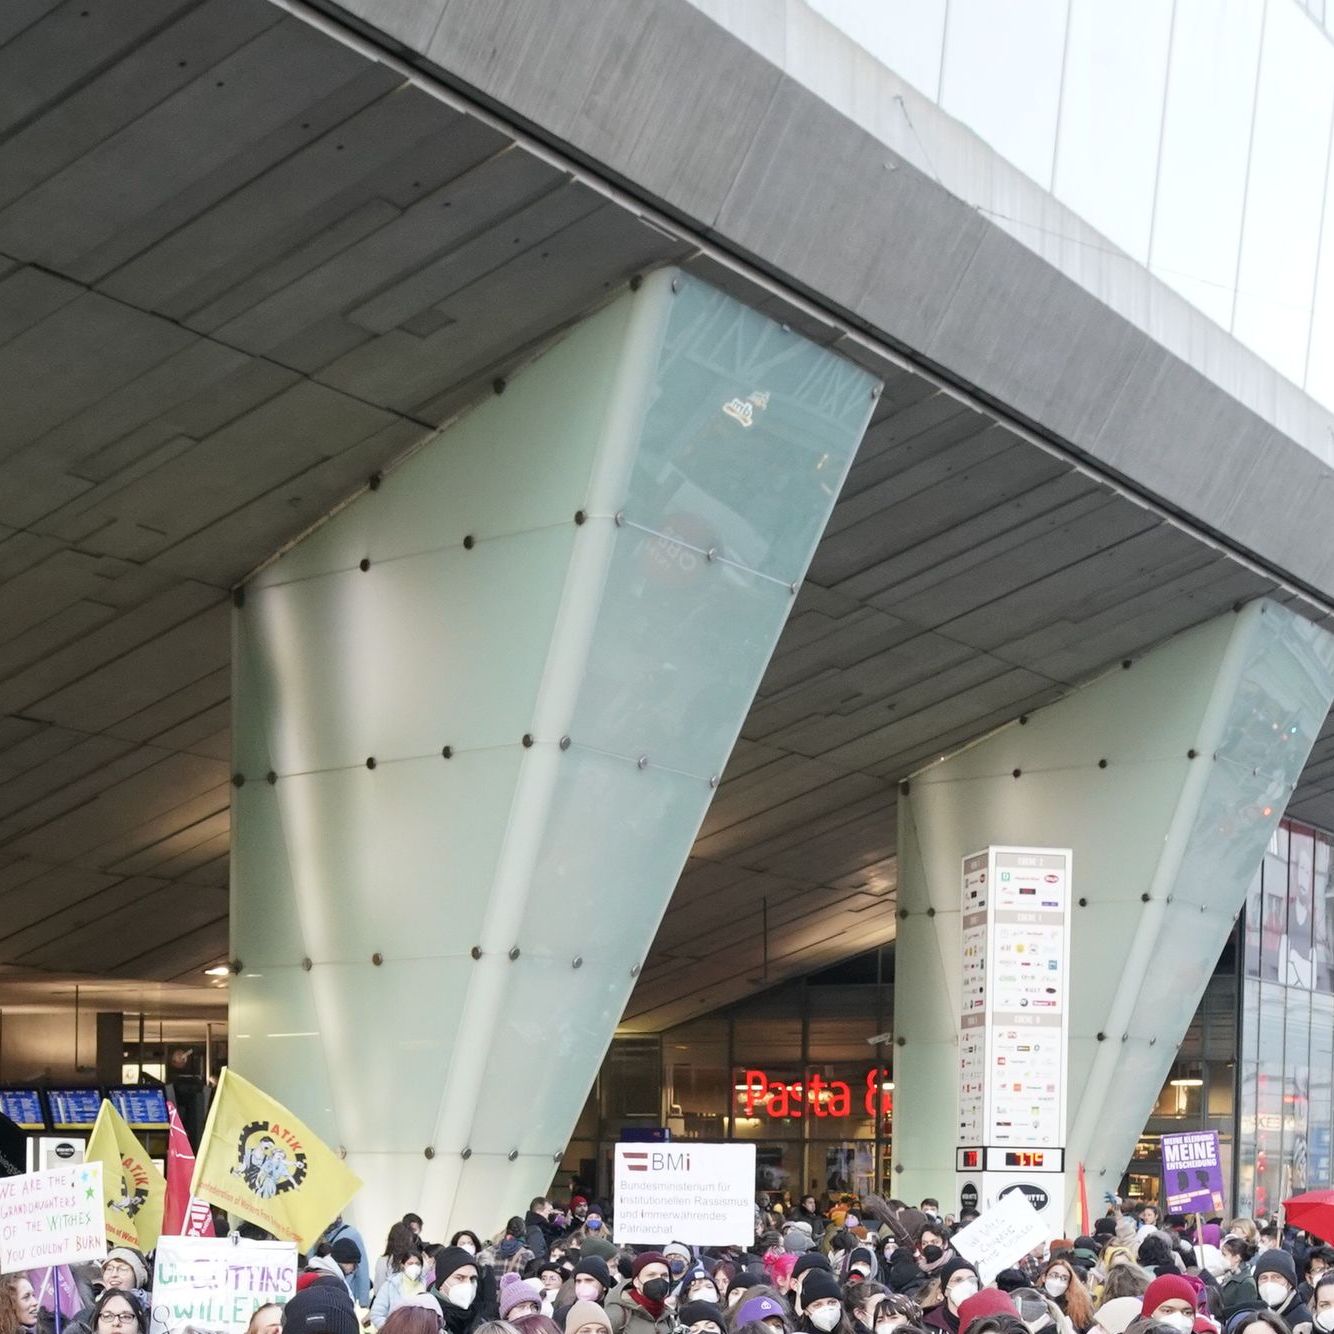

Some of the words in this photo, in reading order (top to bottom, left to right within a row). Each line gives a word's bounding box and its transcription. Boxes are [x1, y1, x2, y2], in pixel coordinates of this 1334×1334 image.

[745, 1069, 852, 1118] Pasta
[1164, 1141, 1216, 1162] MEINE
[1166, 1159, 1218, 1170] ENTSCHEIDUNG
[22, 1179, 42, 1196] ARE
[48, 1175, 66, 1187] THE
[620, 1180, 715, 1192] Bundesministerium
[717, 1182, 732, 1192] für
[0, 1196, 76, 1219] GRANDDAUGHTERS
[694, 1196, 749, 1207] Rassismus
[620, 1210, 638, 1219] und
[3, 1225, 17, 1240] OF
[27, 1221, 42, 1232] THE
[48, 1212, 91, 1232] WITCHES
[620, 1223, 673, 1234] Patriarchat
[7, 1248, 25, 1264] YOU
[75, 1235, 102, 1251] BURN
